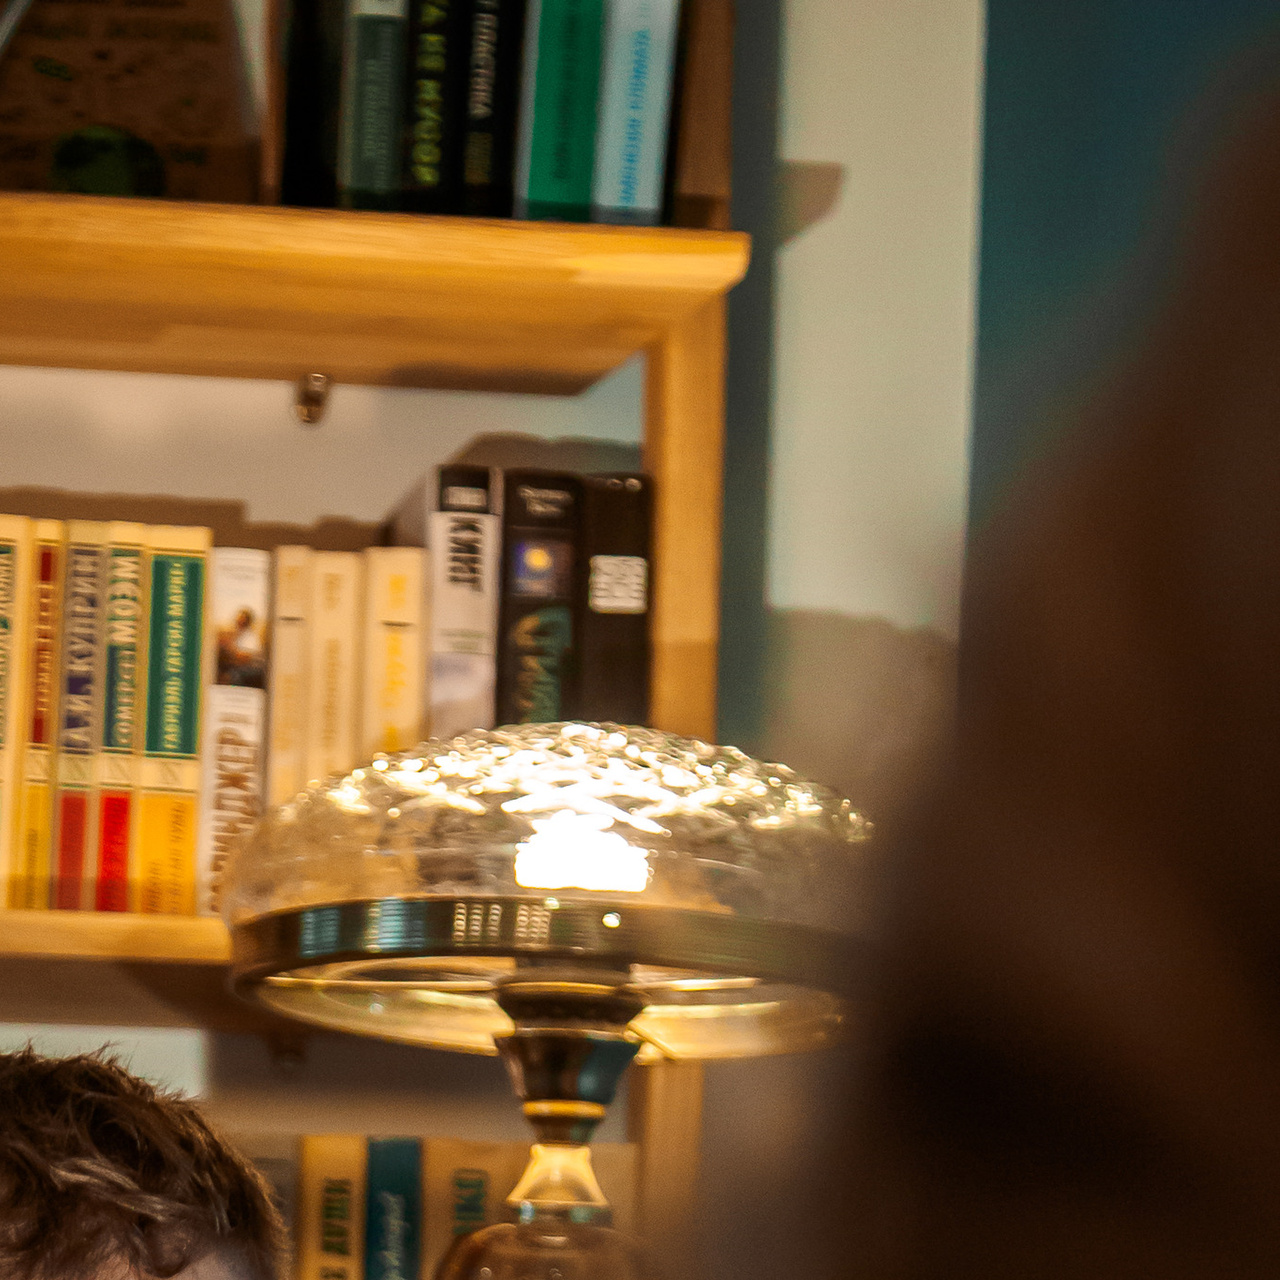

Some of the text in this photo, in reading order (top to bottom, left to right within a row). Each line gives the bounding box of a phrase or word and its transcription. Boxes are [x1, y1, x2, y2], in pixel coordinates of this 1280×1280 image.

[67, 554, 98, 672] КУПРИН
[108, 555, 141, 746] СОМЕРСЕТ МОЭМ
[164, 619, 184, 673] ГАРСИА
[162, 677, 183, 749] ГАБРИЭЛЬ
[320, 1178, 352, 1256] ДУШИ
